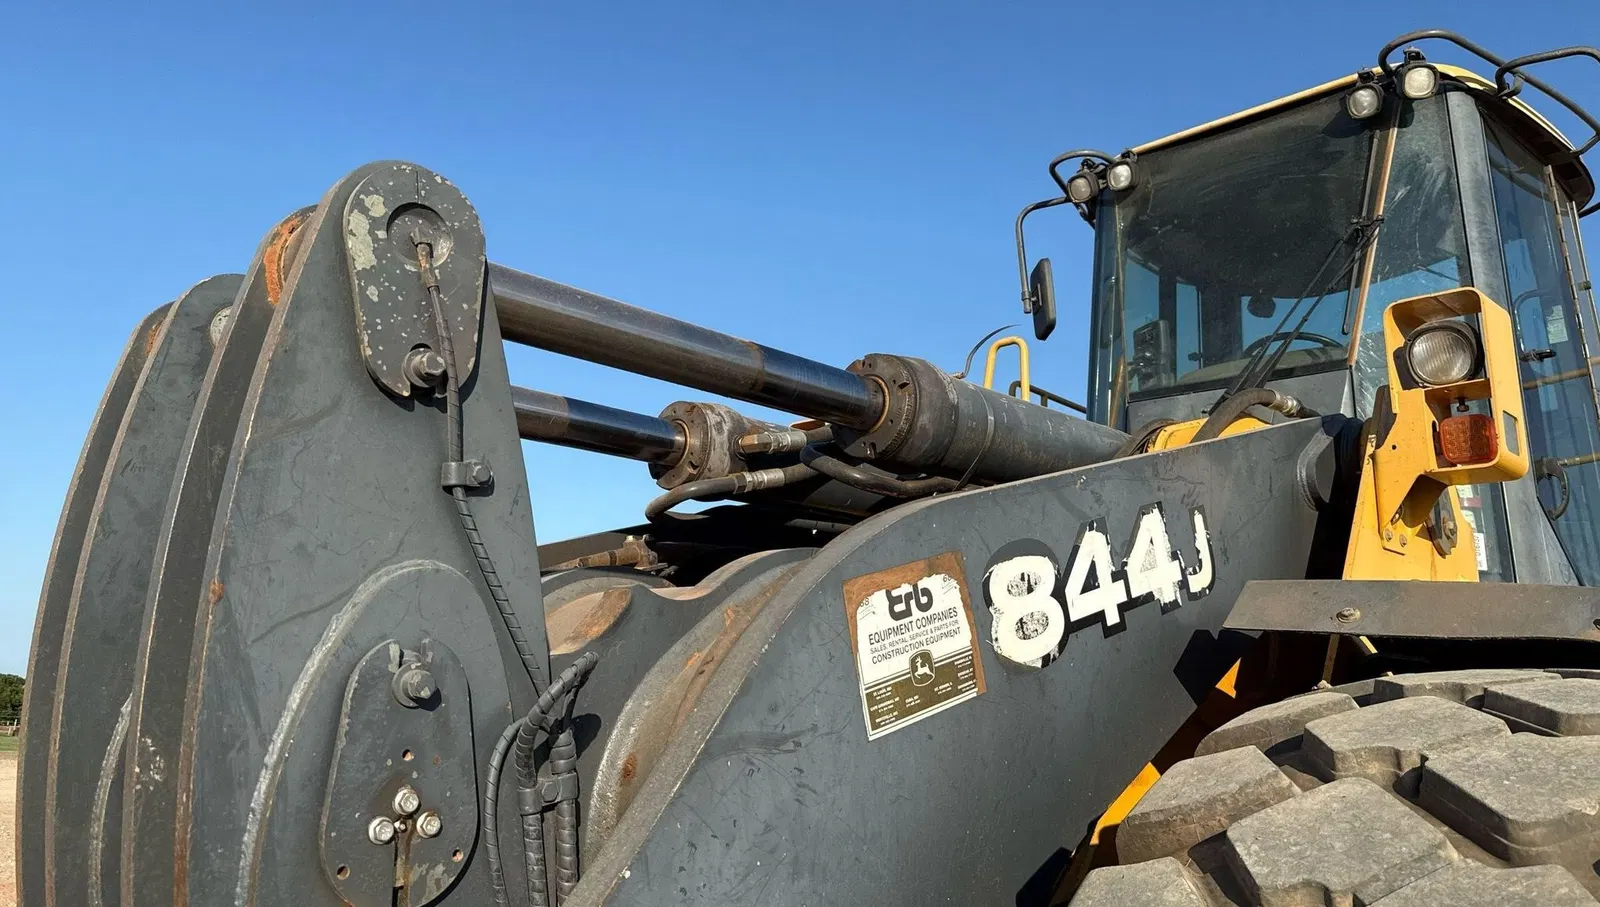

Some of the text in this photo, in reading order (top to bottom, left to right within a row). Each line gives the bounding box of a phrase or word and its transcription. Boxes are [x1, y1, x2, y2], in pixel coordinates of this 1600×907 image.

[983, 501, 1215, 668] 844J
[868, 606, 958, 646] EQUIPMENT COMPANIES
[871, 626, 961, 665] CONSTRUCTION EQUIPMENT
[909, 629, 929, 641] SERVICE
[934, 622, 949, 632] PARTS
[949, 619, 960, 628] FOR
